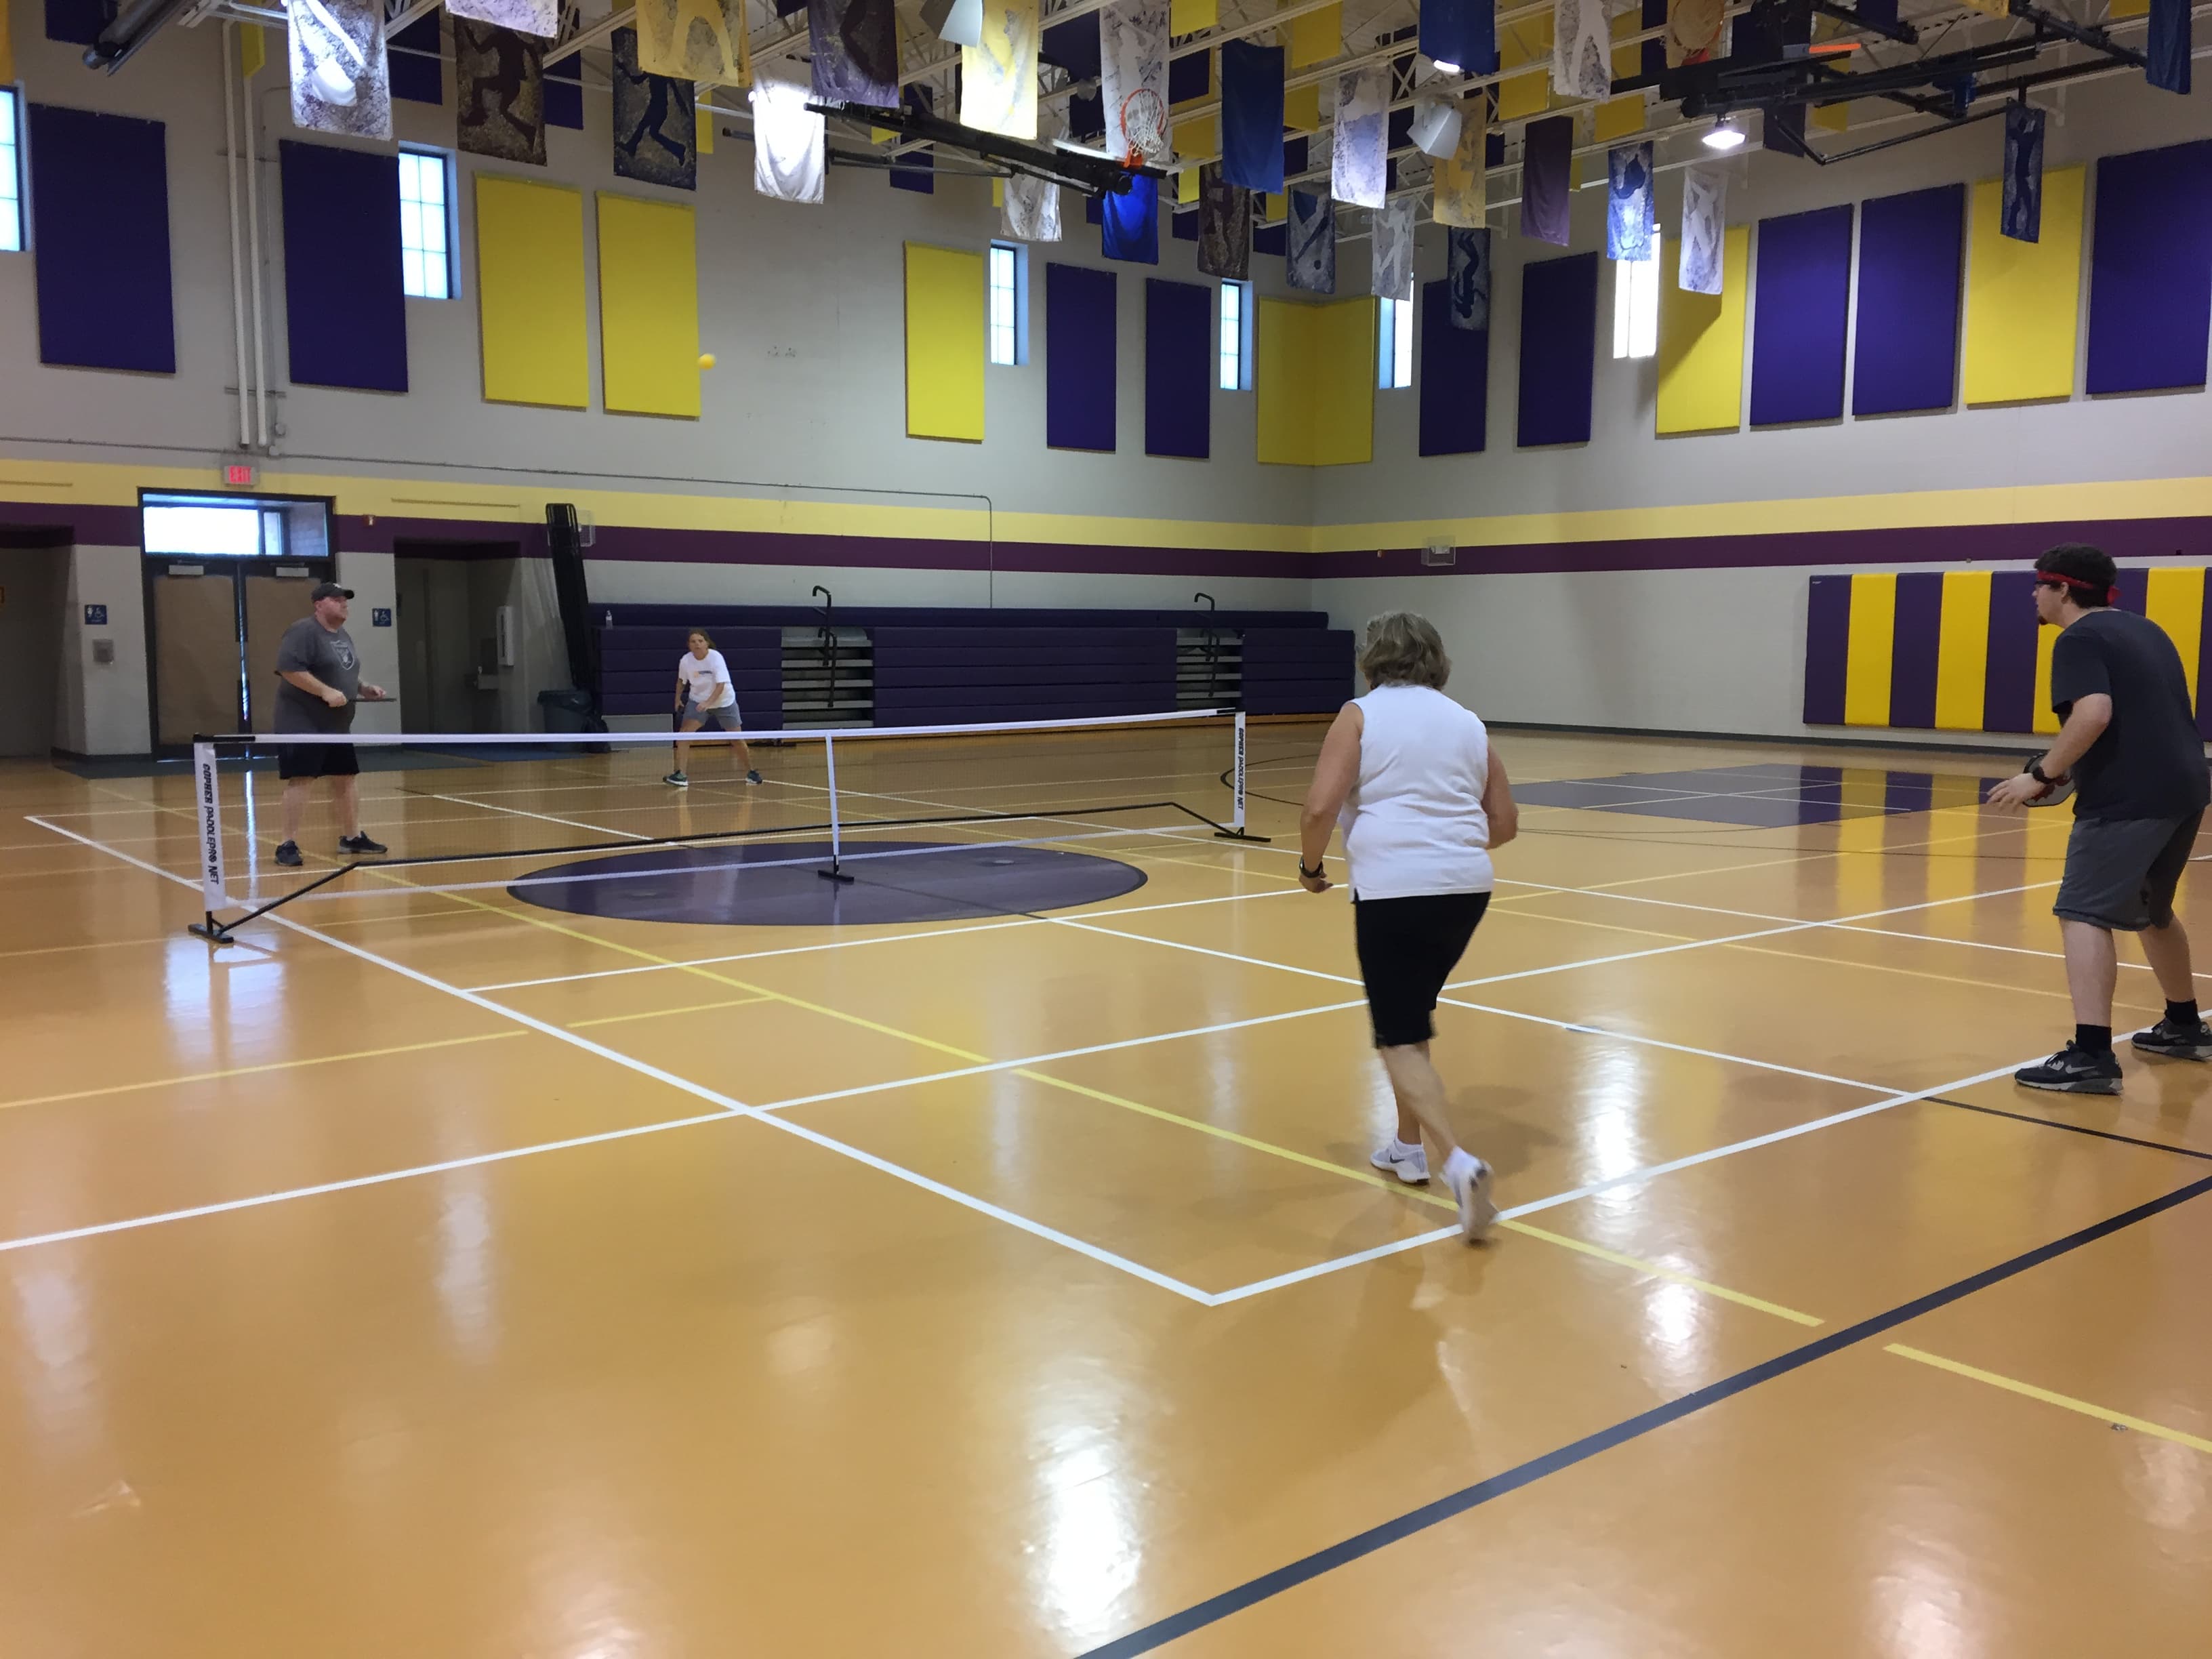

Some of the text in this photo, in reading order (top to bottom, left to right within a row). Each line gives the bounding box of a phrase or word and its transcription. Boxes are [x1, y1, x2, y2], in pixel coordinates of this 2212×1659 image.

[230, 466, 251, 483] EXIT
[202, 763, 220, 885] GOPHER PADDLEPRO NET
